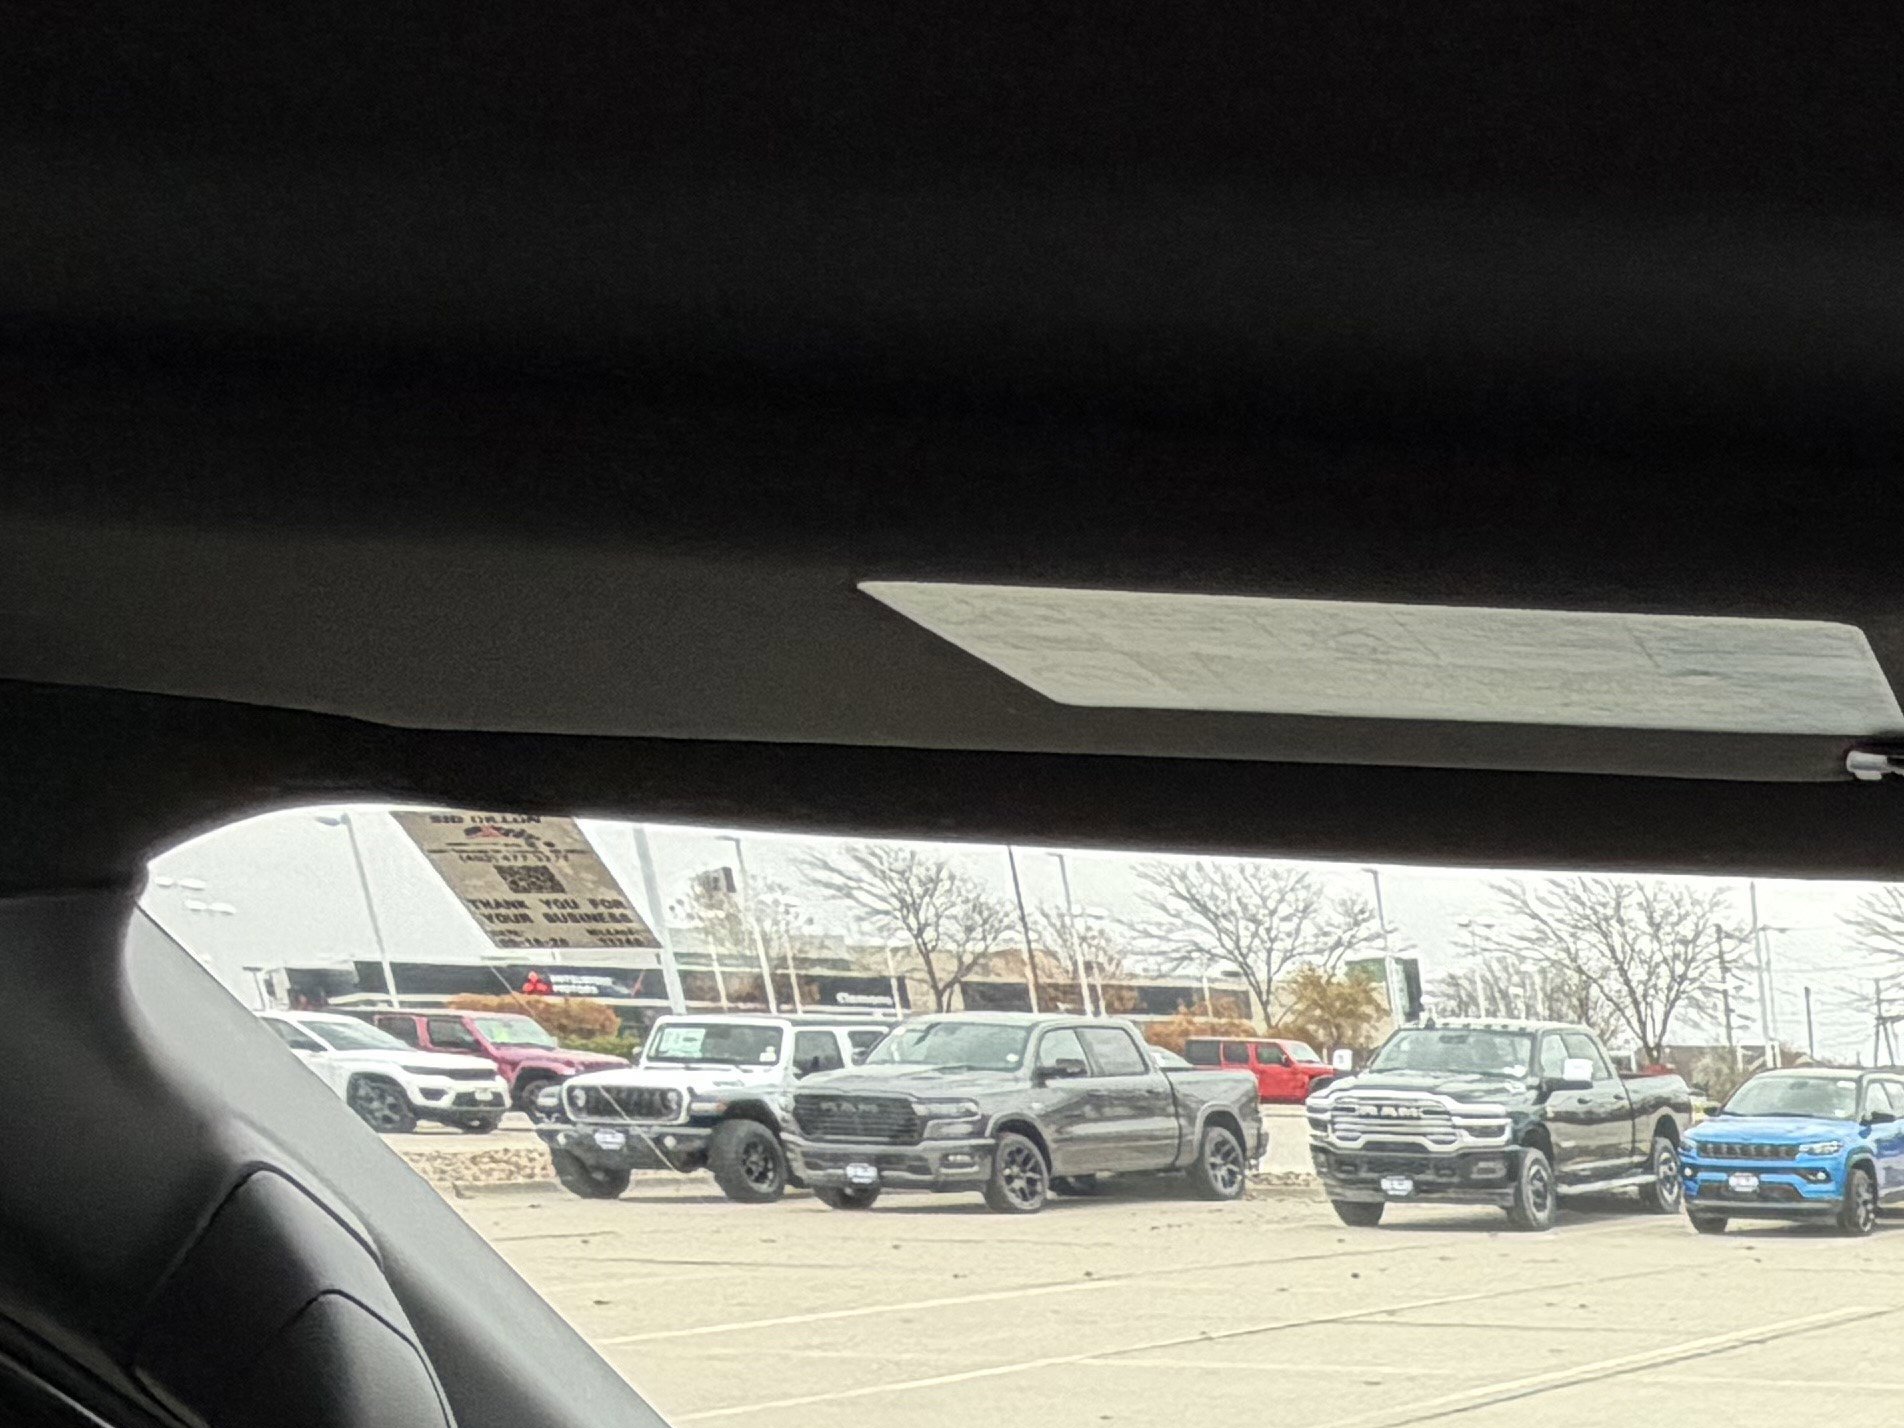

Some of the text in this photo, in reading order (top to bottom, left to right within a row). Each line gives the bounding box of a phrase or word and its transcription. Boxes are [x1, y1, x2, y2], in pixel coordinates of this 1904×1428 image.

[468, 898, 627, 910] THANK YOU FOR
[479, 912, 634, 924] YOUR BUSINESS
